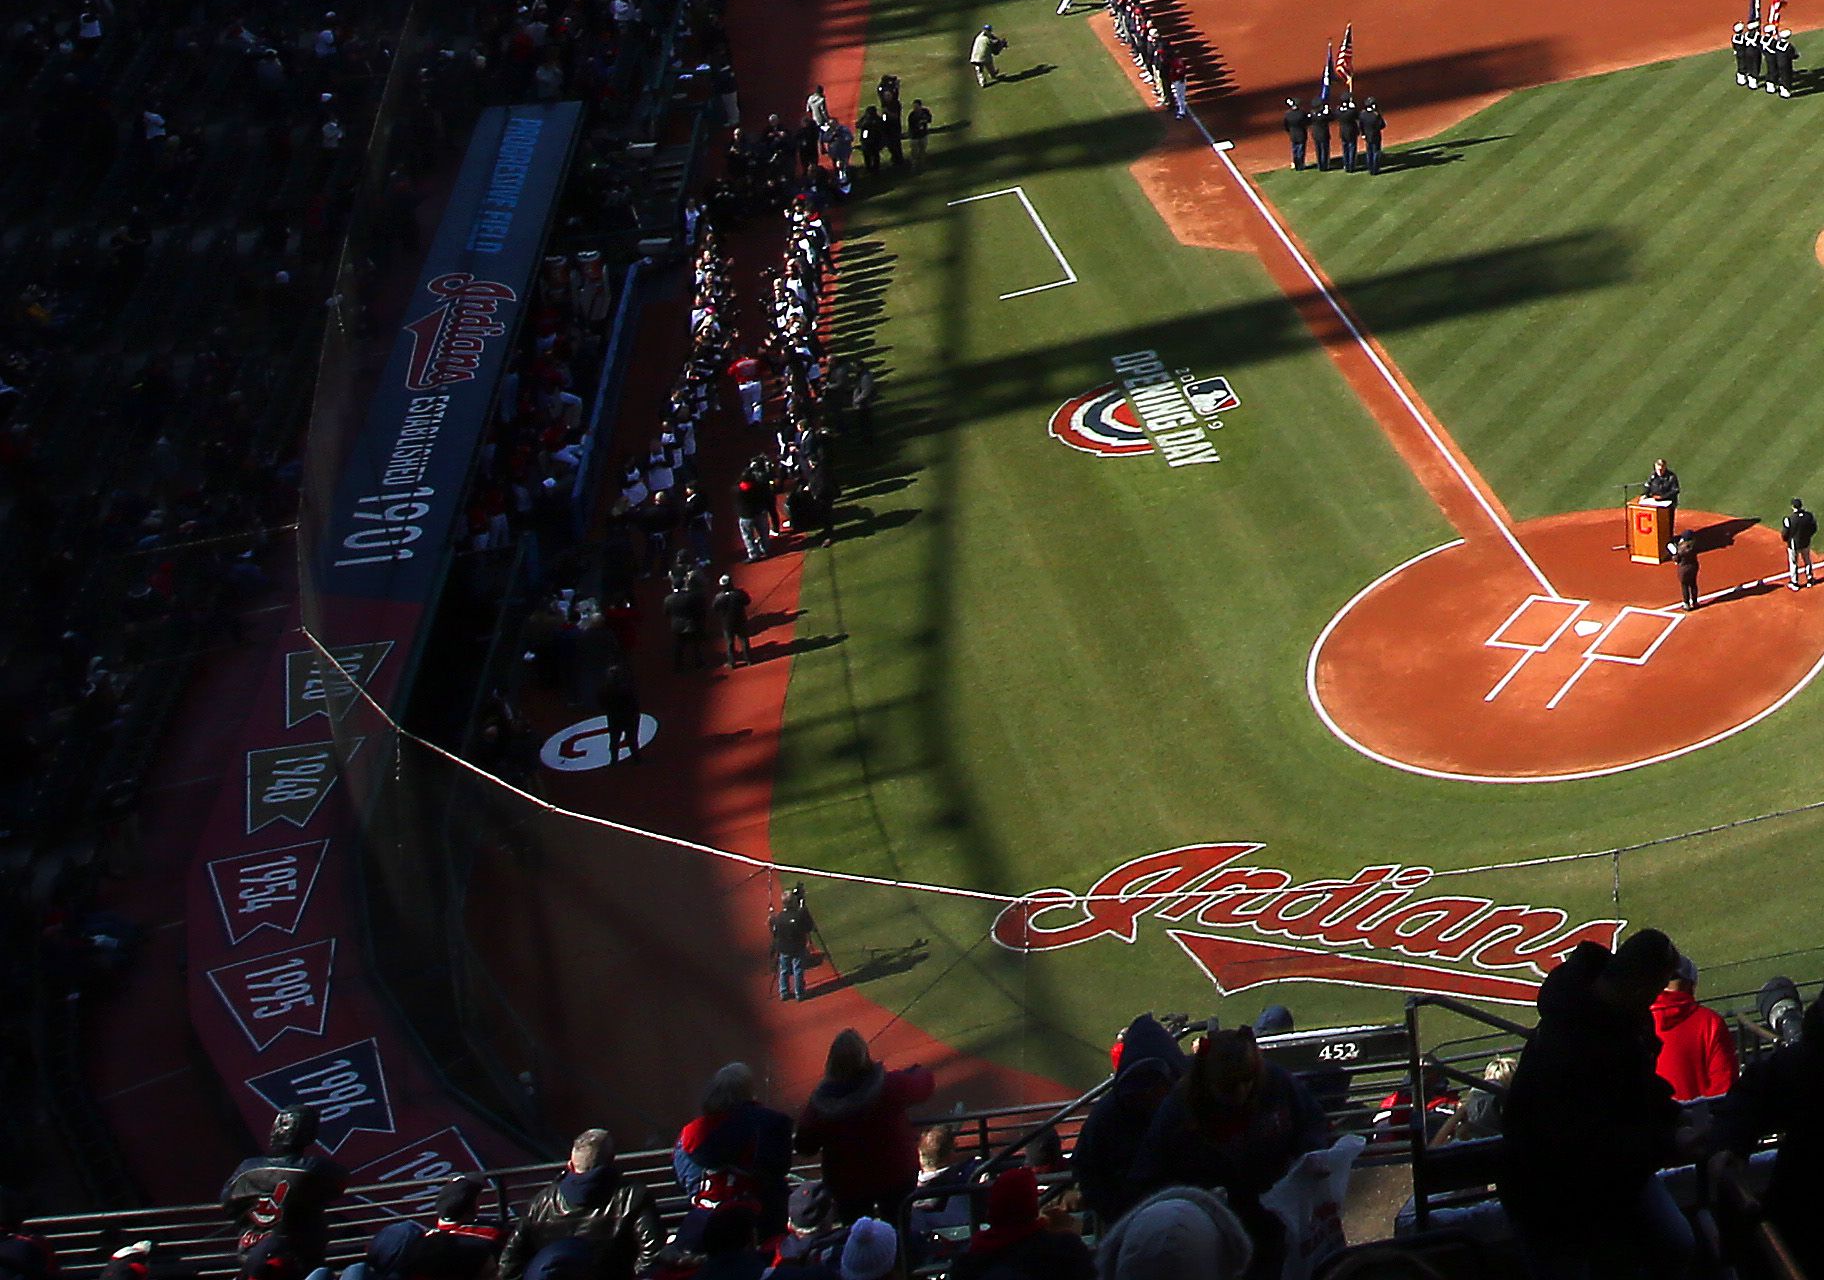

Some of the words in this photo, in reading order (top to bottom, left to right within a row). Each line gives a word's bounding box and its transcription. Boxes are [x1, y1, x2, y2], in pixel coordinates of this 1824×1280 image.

[479, 116, 543, 208] PROGRESSIVE
[424, 272, 518, 392] Indians
[1111, 349, 1198, 433] OPENING
[382, 395, 450, 486] ESTABLISHED
[1154, 426, 1222, 468] DAY
[334, 486, 435, 568] 1901
[262, 752, 321, 805] 1948
[238, 855, 298, 915] 1954
[992, 843, 1628, 980] Indians
[245, 957, 316, 1021] 1995
[1318, 1042, 1359, 1062] 452
[290, 1058, 368, 1124] 1996
